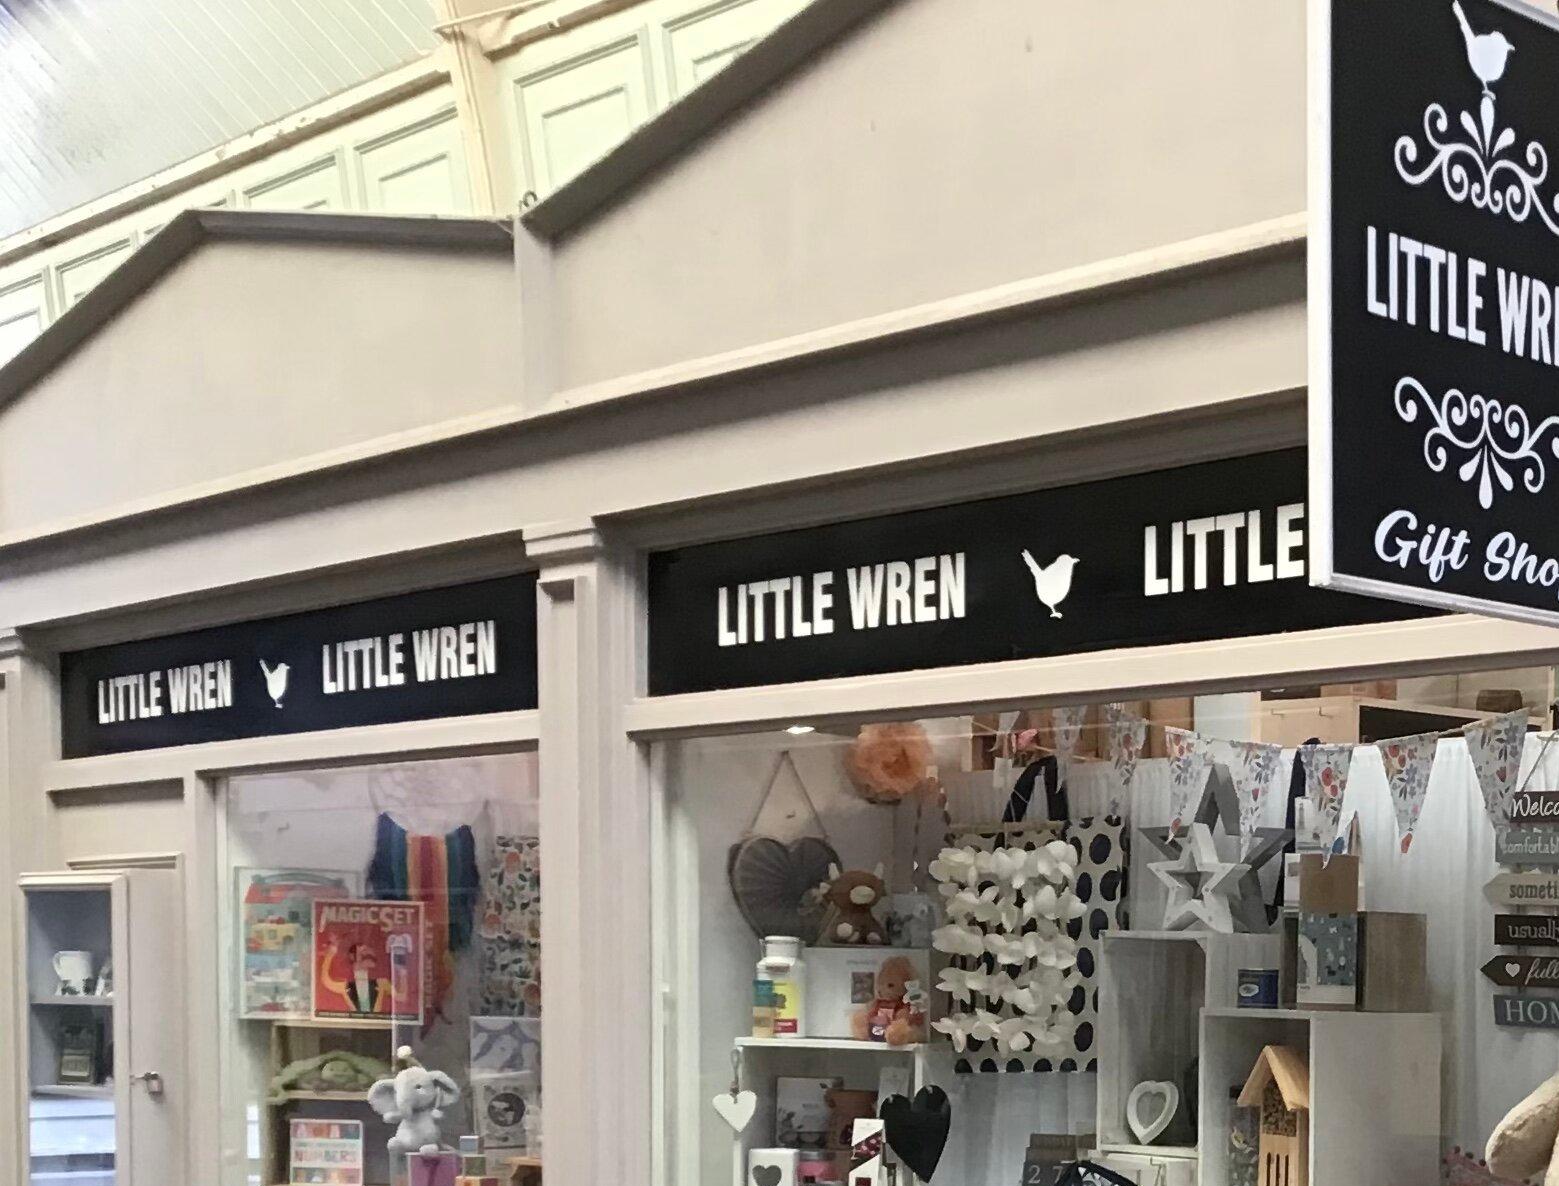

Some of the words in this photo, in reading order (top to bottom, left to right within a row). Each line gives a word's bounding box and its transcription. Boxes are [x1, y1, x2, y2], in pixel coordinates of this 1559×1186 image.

[1366, 226, 1487, 346] LITTLE
[1144, 503, 1306, 596] LITTLE
[1374, 509, 1471, 583] Gift
[718, 571, 835, 647] LITTLE
[846, 552, 966, 630] WREN
[98, 671, 163, 724] LITTLE
[167, 659, 232, 714] WREN
[322, 633, 405, 694] LITTLE
[412, 620, 497, 682] WREN
